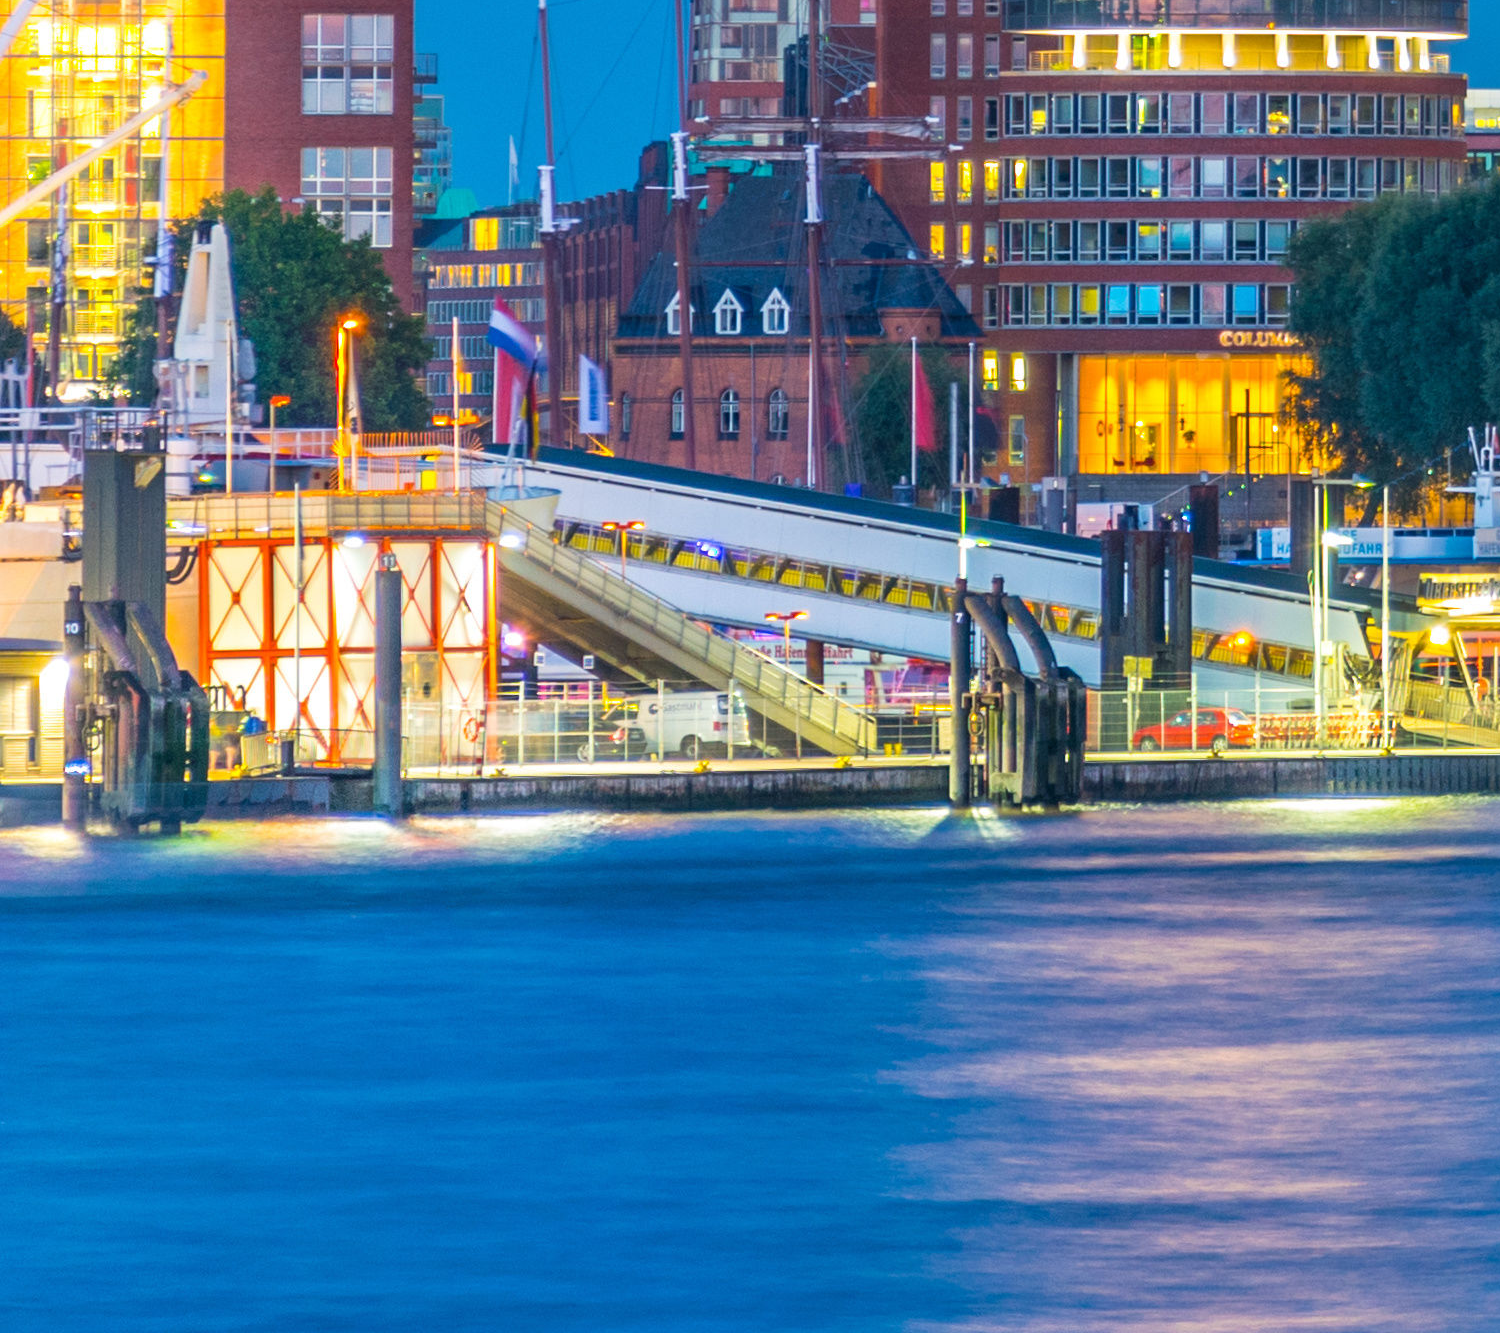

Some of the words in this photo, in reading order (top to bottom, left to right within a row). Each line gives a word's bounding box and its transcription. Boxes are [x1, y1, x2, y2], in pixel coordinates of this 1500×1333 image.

[1219, 330, 1303, 347] COLUM
[383, 556, 395, 568] 11
[955, 612, 963, 623] 7
[65, 622, 79, 634] 10
